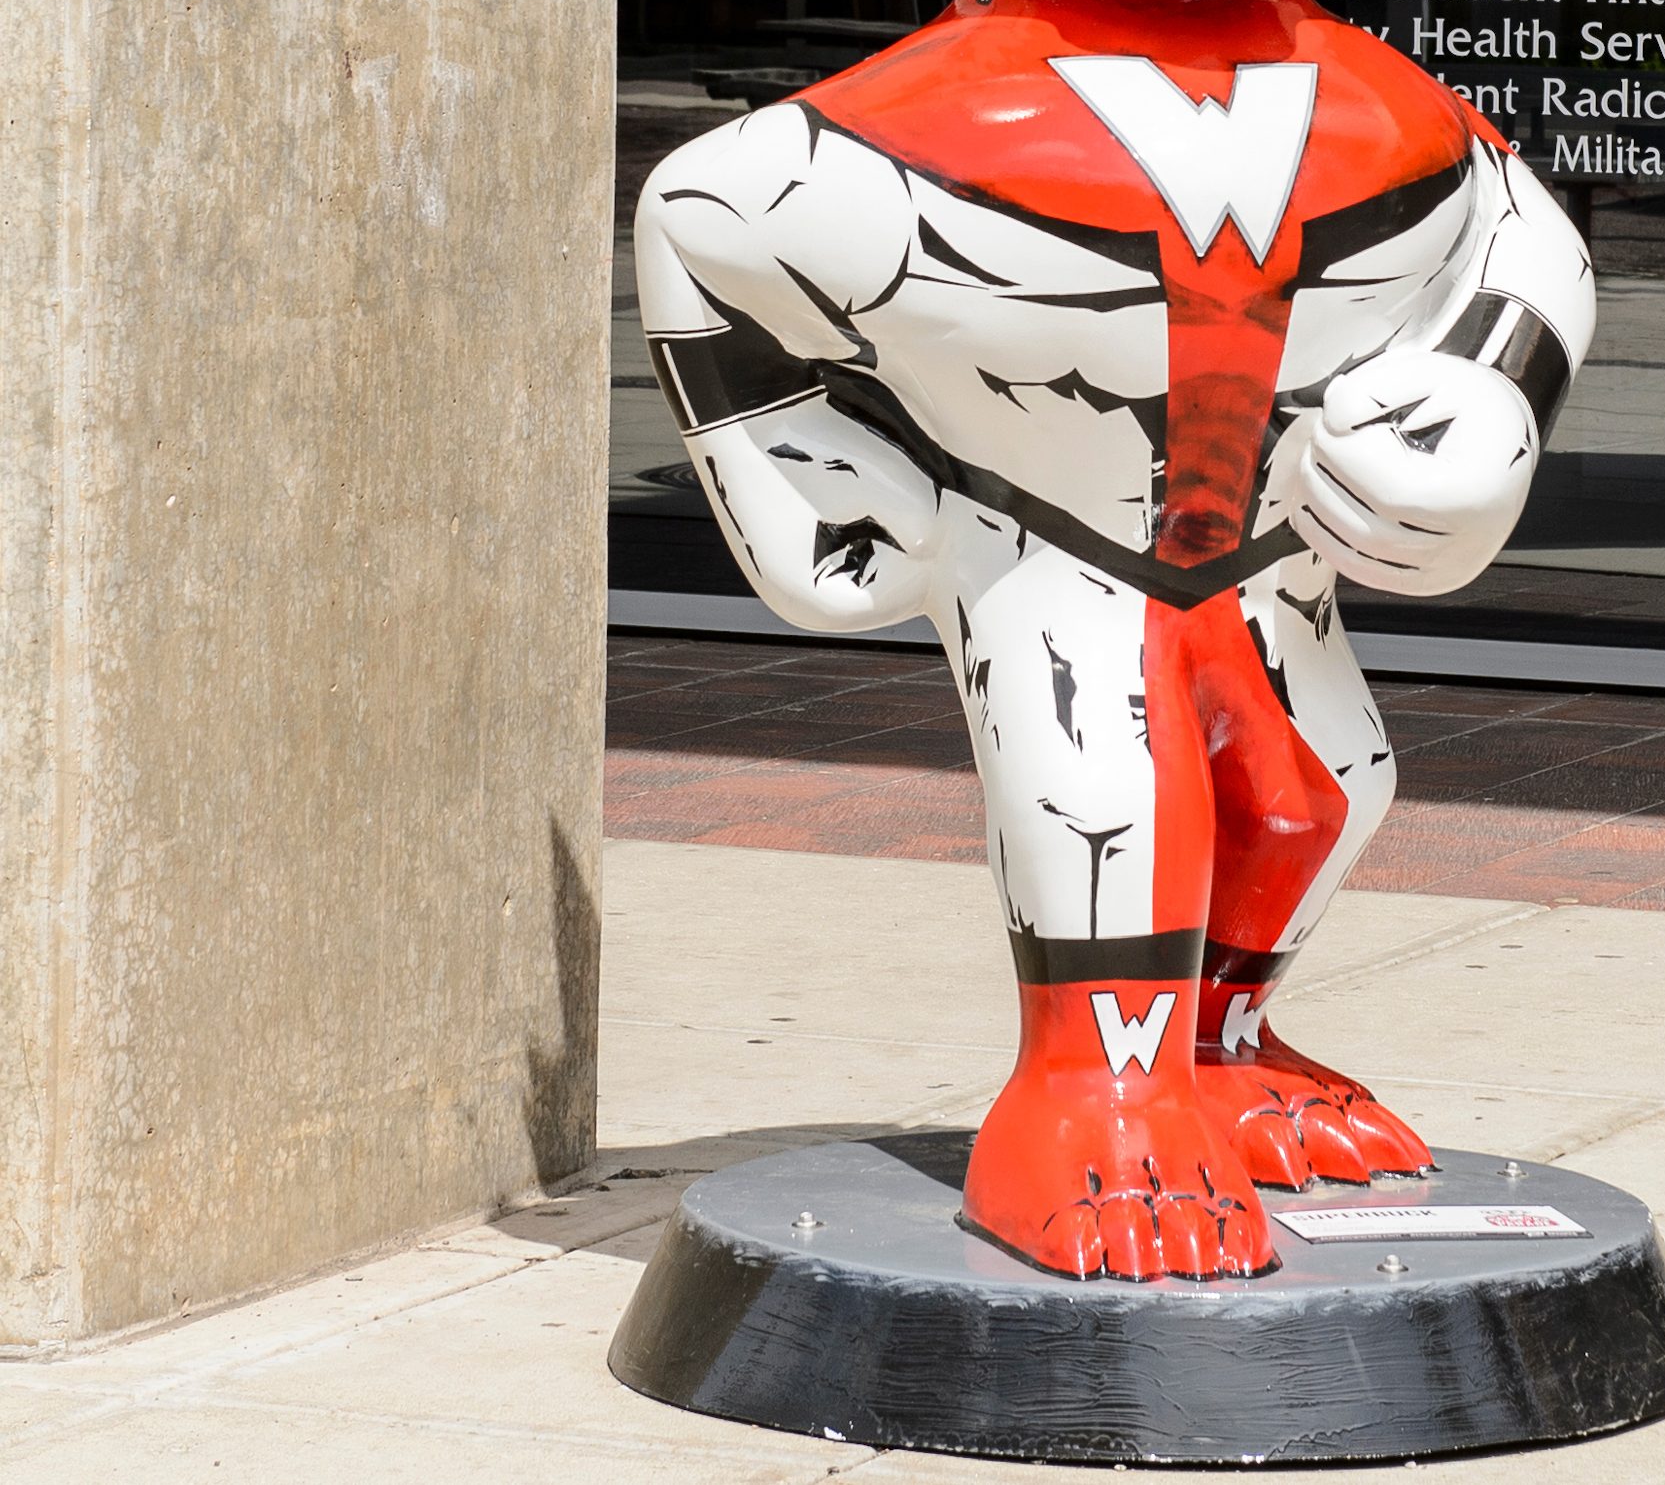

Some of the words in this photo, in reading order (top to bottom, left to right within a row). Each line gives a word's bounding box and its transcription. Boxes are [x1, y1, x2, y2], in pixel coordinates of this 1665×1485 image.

[1412, 17, 1558, 60] Health
[1047, 54, 1319, 267] W
[1090, 992, 1178, 1077] W
